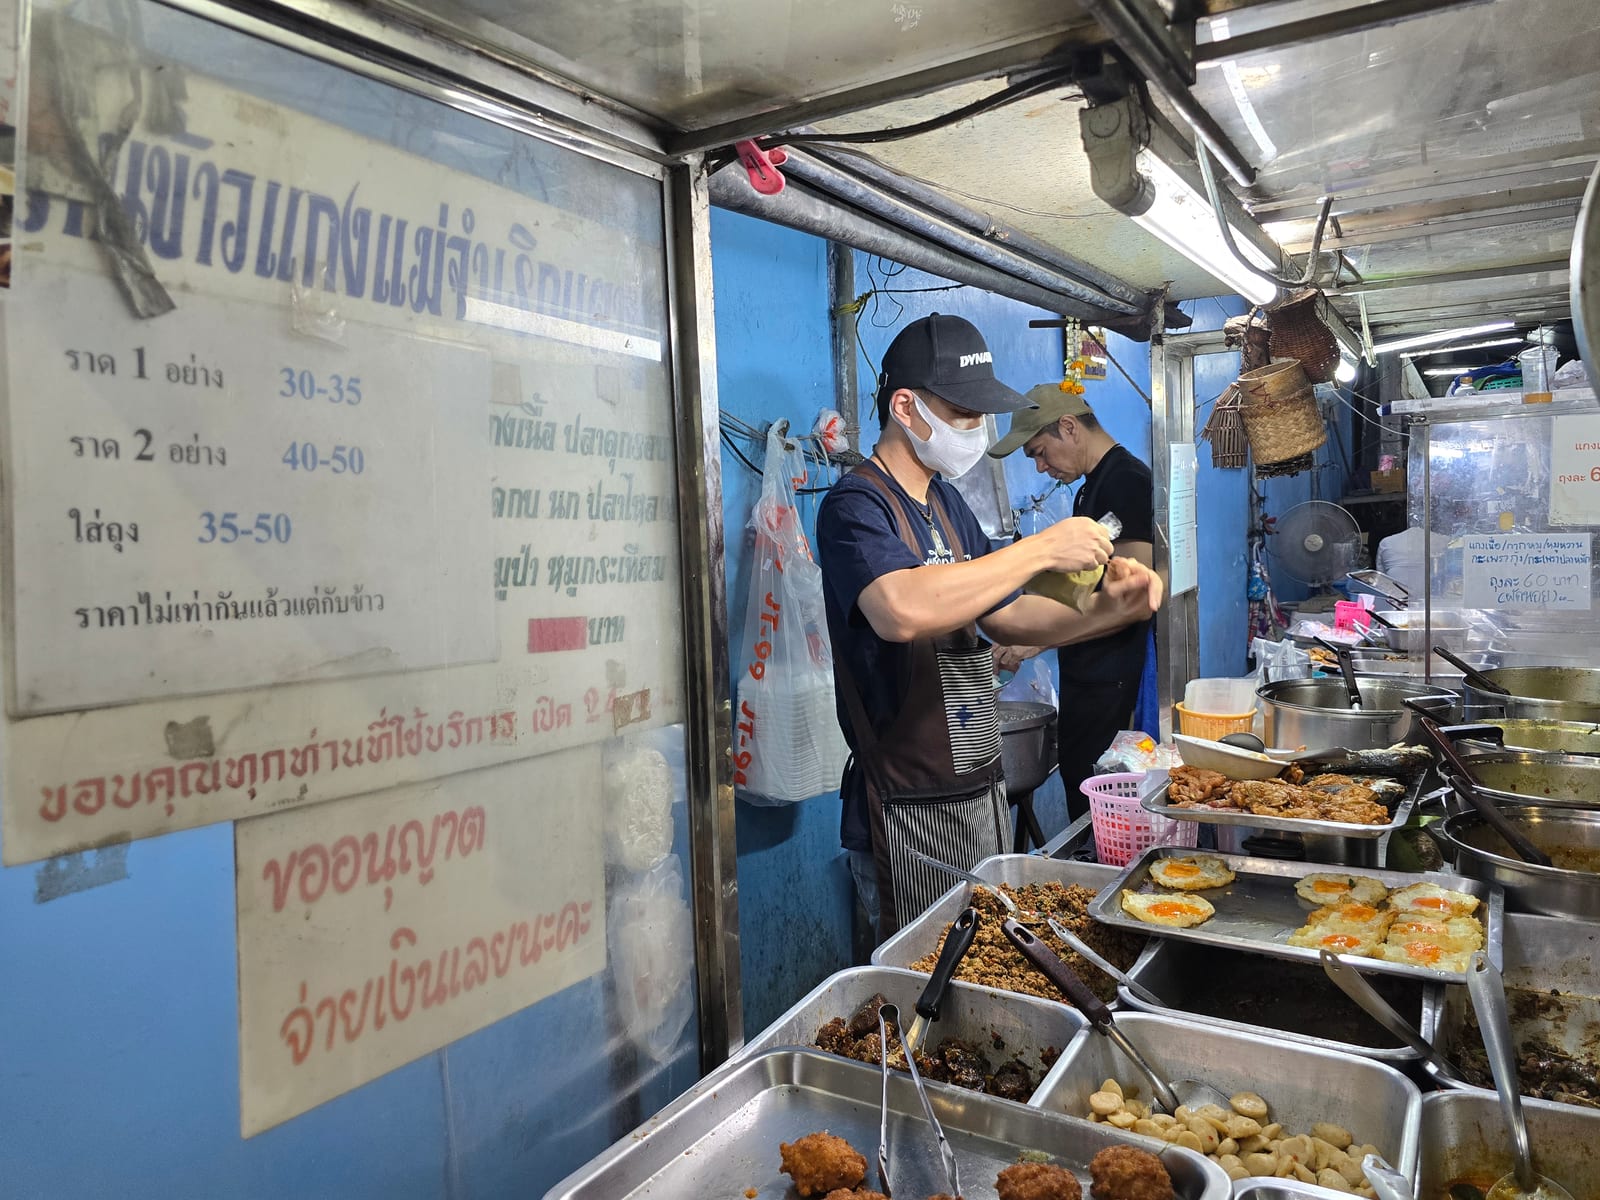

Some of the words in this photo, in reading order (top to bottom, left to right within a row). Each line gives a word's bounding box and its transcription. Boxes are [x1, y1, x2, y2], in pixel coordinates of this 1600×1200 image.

[65, 348, 116, 377] ราด
[132, 346, 150, 380] 1
[165, 353, 224, 389] อย่าง
[279, 366, 362, 406] 30-35
[959, 351, 993, 368] DYNA
[69, 434, 120, 461] ราด
[133, 427, 155, 462] 2
[169, 433, 228, 467] อย่าง
[282, 440, 365, 476] 40-50
[68, 507, 140, 553] ใส่ถุง
[197, 510, 292, 545] 35-50
[1523, 573, 1549, 588] 60
[75, 585, 386, 629] ราคาไม่เท่ากันแล้วแต่กับข้าว
[588, 615, 626, 646] บาท
[748, 591, 781, 681] JT-99
[263, 805, 486, 914] ขออนุญาต
[280, 900, 593, 1067] จ่ายเงินเลยนะคะ
